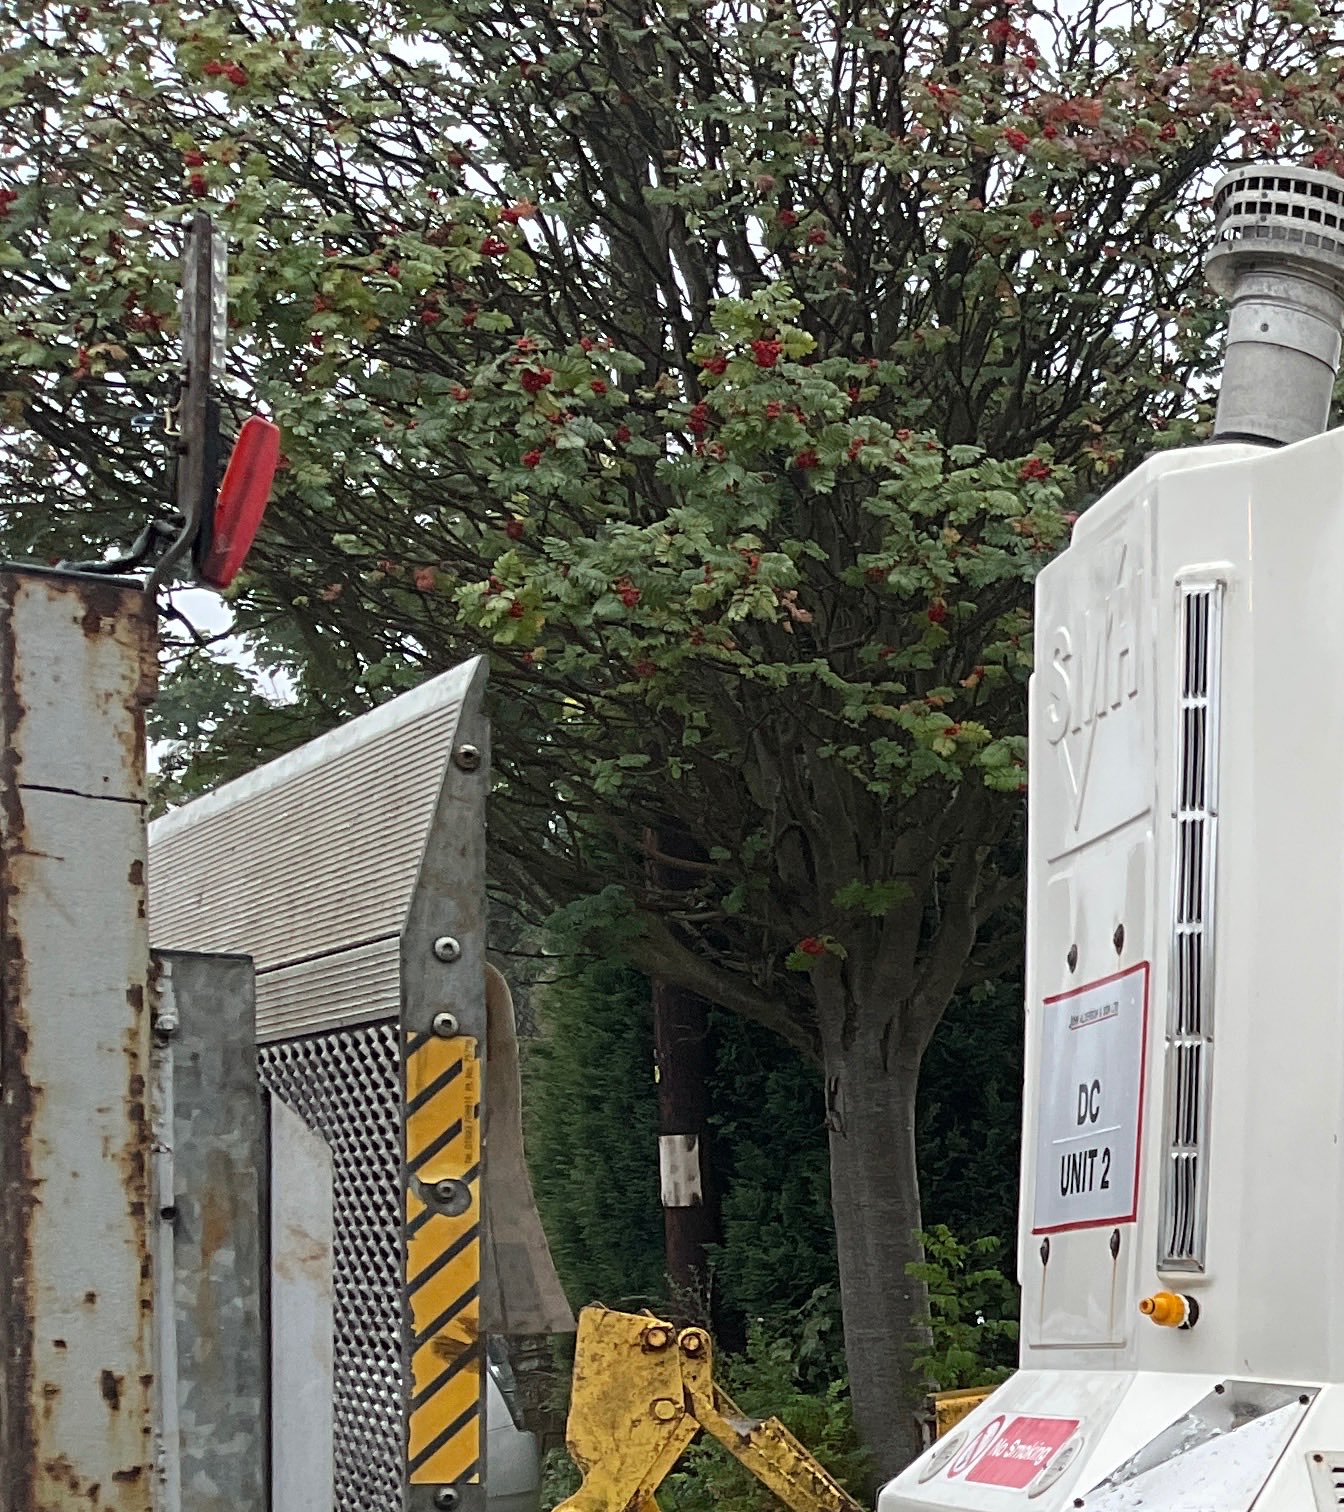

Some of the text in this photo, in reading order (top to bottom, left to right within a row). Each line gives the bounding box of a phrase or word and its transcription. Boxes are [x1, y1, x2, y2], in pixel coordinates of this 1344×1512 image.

[1077, 1079, 1101, 1126] DC
[1060, 1147, 1111, 1197] UNIT 2
[992, 1438, 1054, 1466] No Smoking
